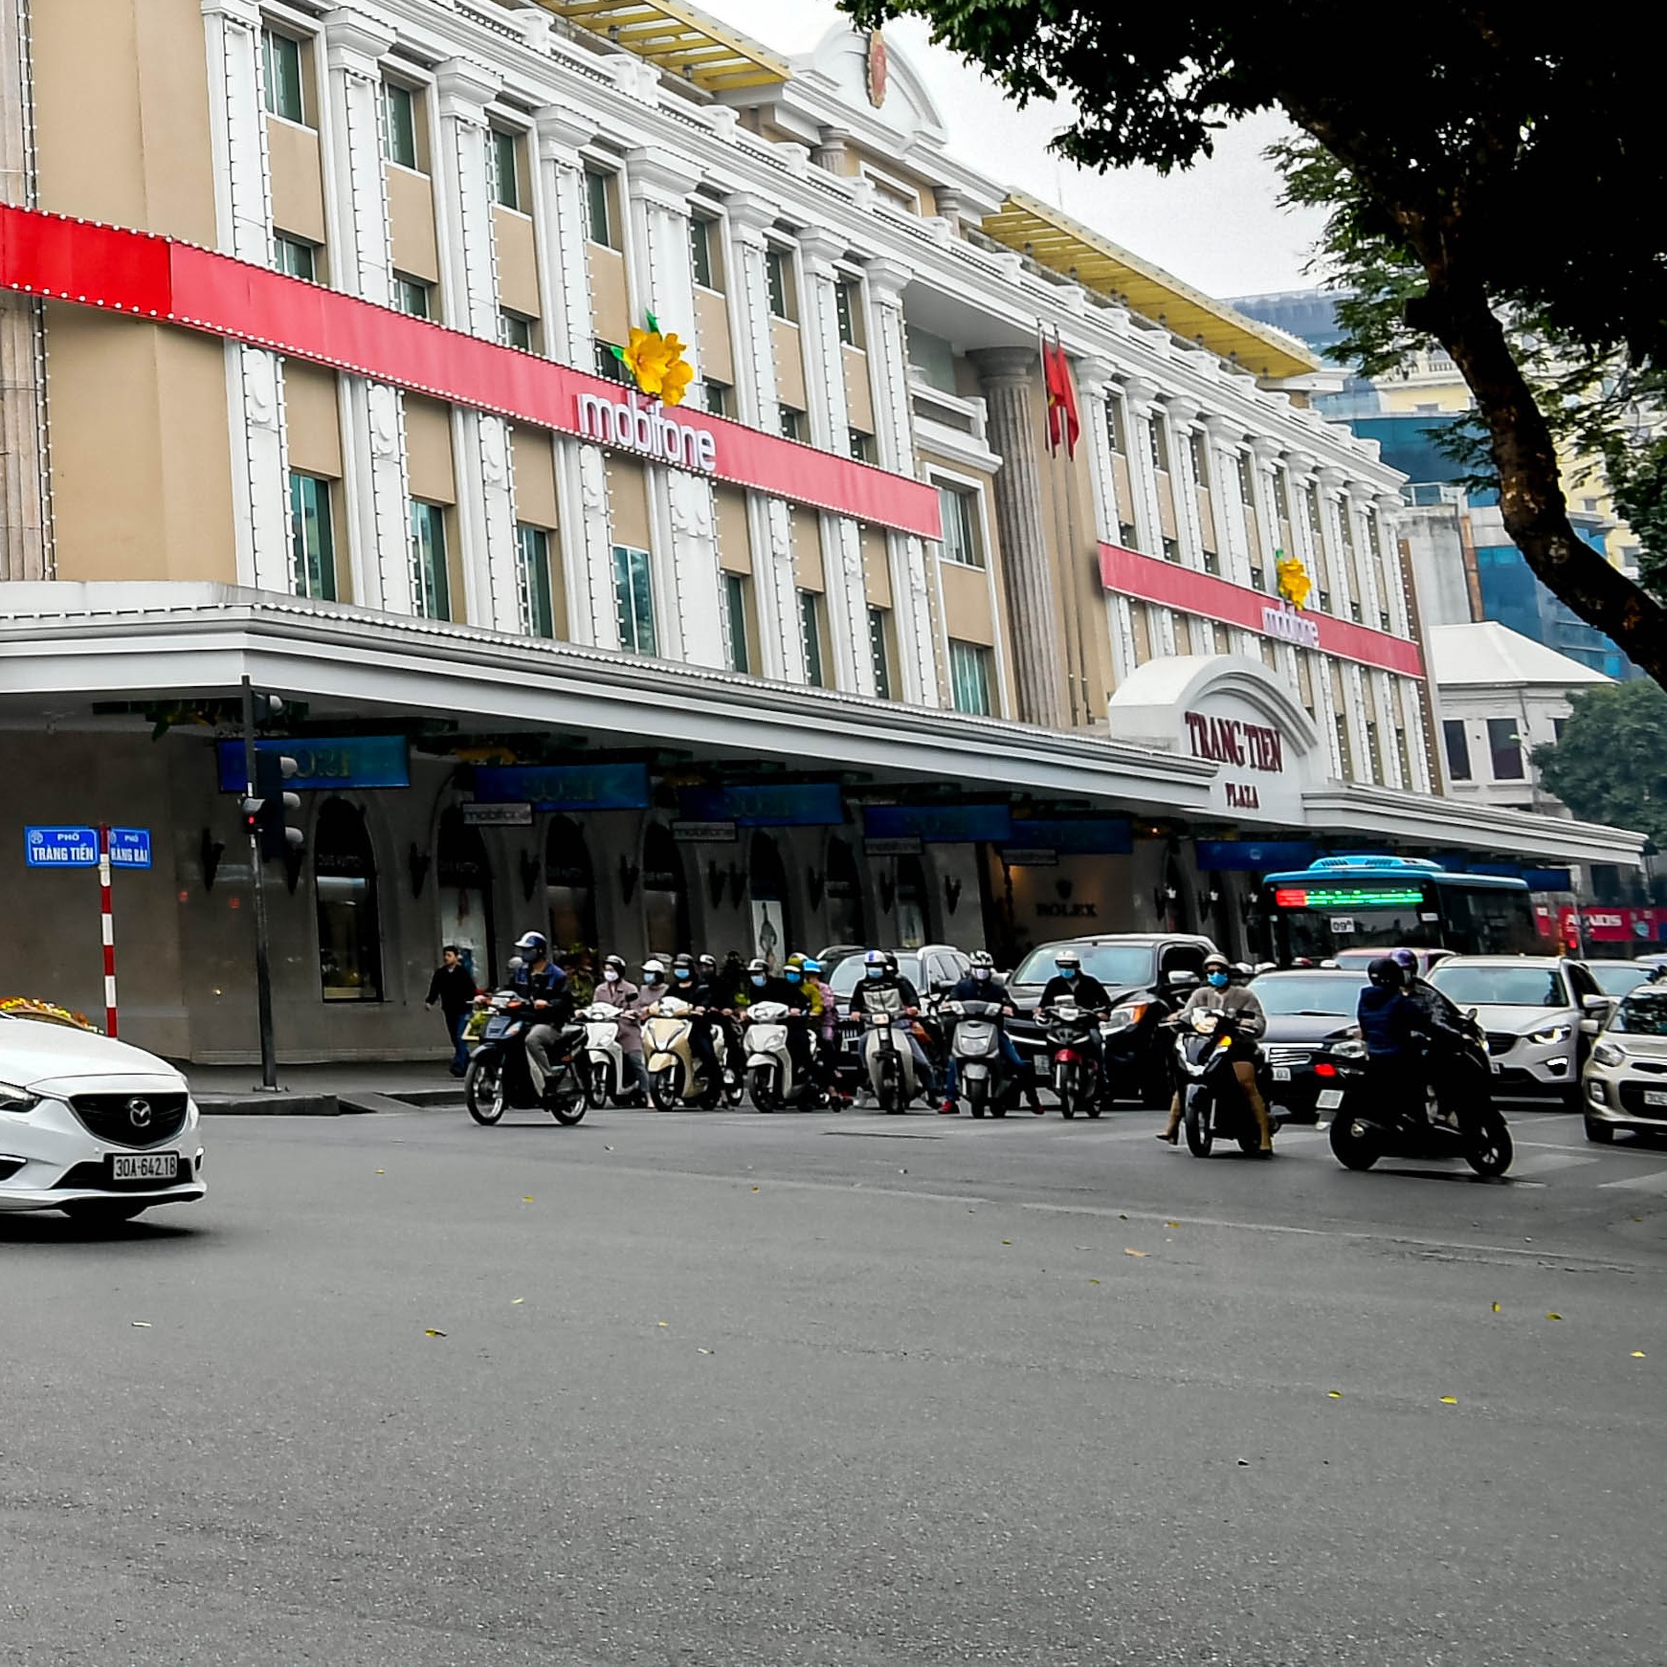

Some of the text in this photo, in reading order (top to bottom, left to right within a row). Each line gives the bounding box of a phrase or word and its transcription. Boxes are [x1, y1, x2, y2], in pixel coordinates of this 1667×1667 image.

[576, 389, 716, 471] mobifone
[1184, 711, 1283, 773] TRANG TIEN
[1225, 782, 1259, 809] PLAZA
[1036, 903, 1097, 917] ROLEX
